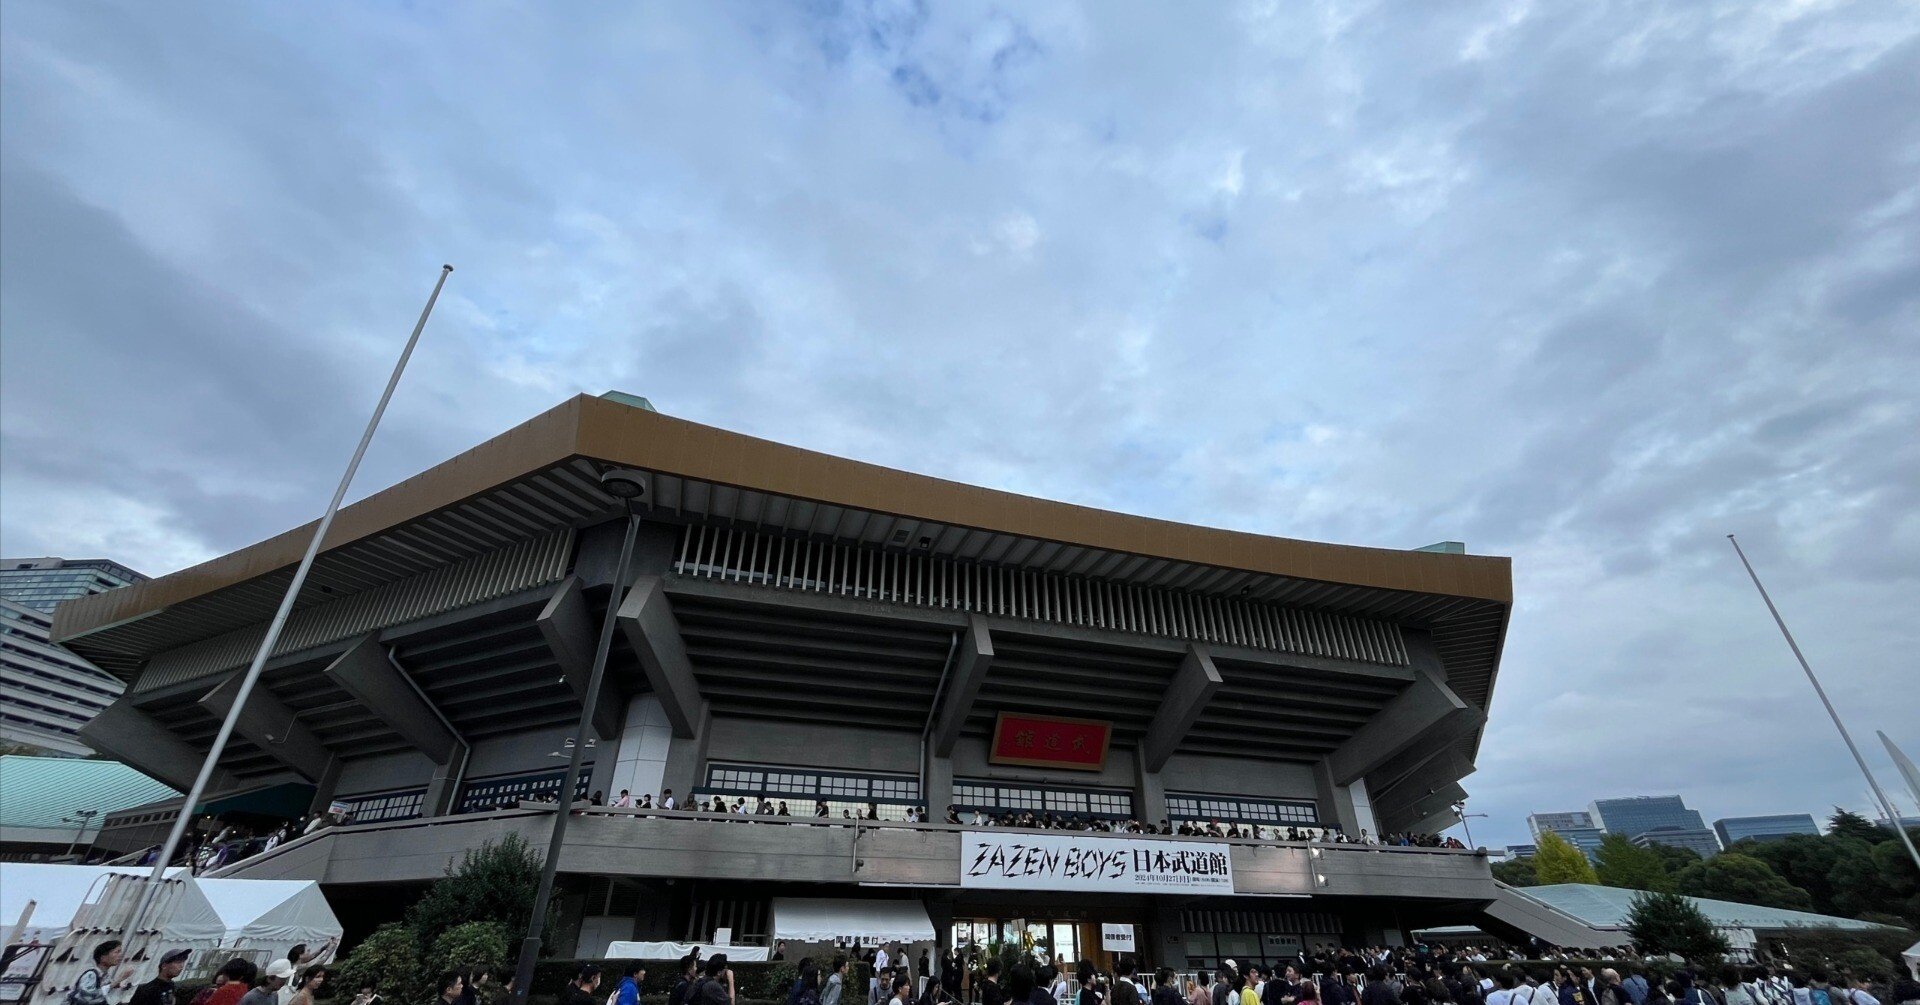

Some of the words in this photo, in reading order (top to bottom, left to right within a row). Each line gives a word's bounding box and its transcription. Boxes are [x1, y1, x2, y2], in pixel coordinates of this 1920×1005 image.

[966, 843, 1060, 879] ZAZEN
[1062, 846, 1130, 880] BOYS
[1133, 848, 1228, 876] 日本武道館
